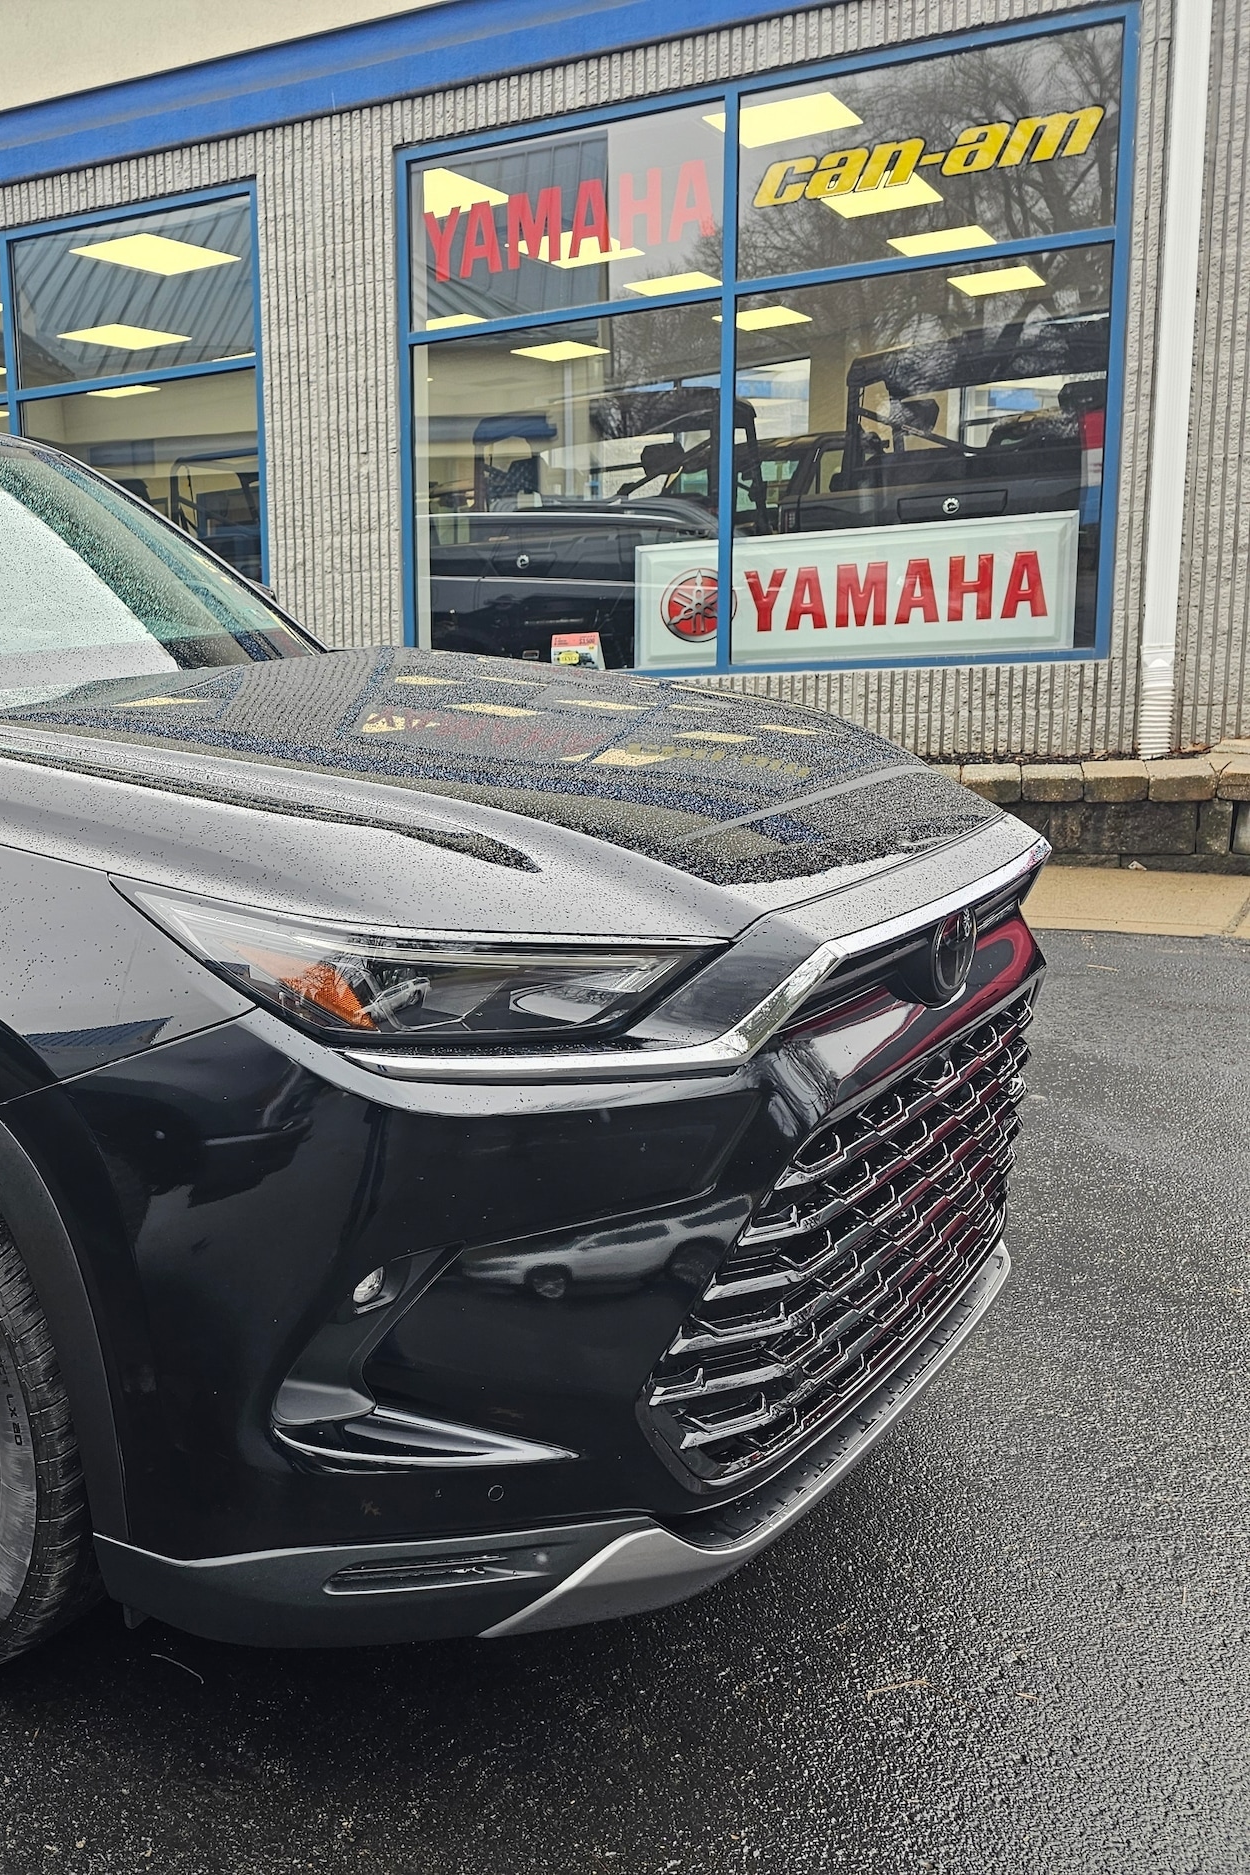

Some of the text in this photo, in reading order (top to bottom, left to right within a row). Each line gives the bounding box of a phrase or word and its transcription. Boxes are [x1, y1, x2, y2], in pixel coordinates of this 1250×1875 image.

[752, 103, 1106, 209] can-am
[423, 158, 716, 284] YAMAHA
[744, 550, 1049, 632] YAMAHA
